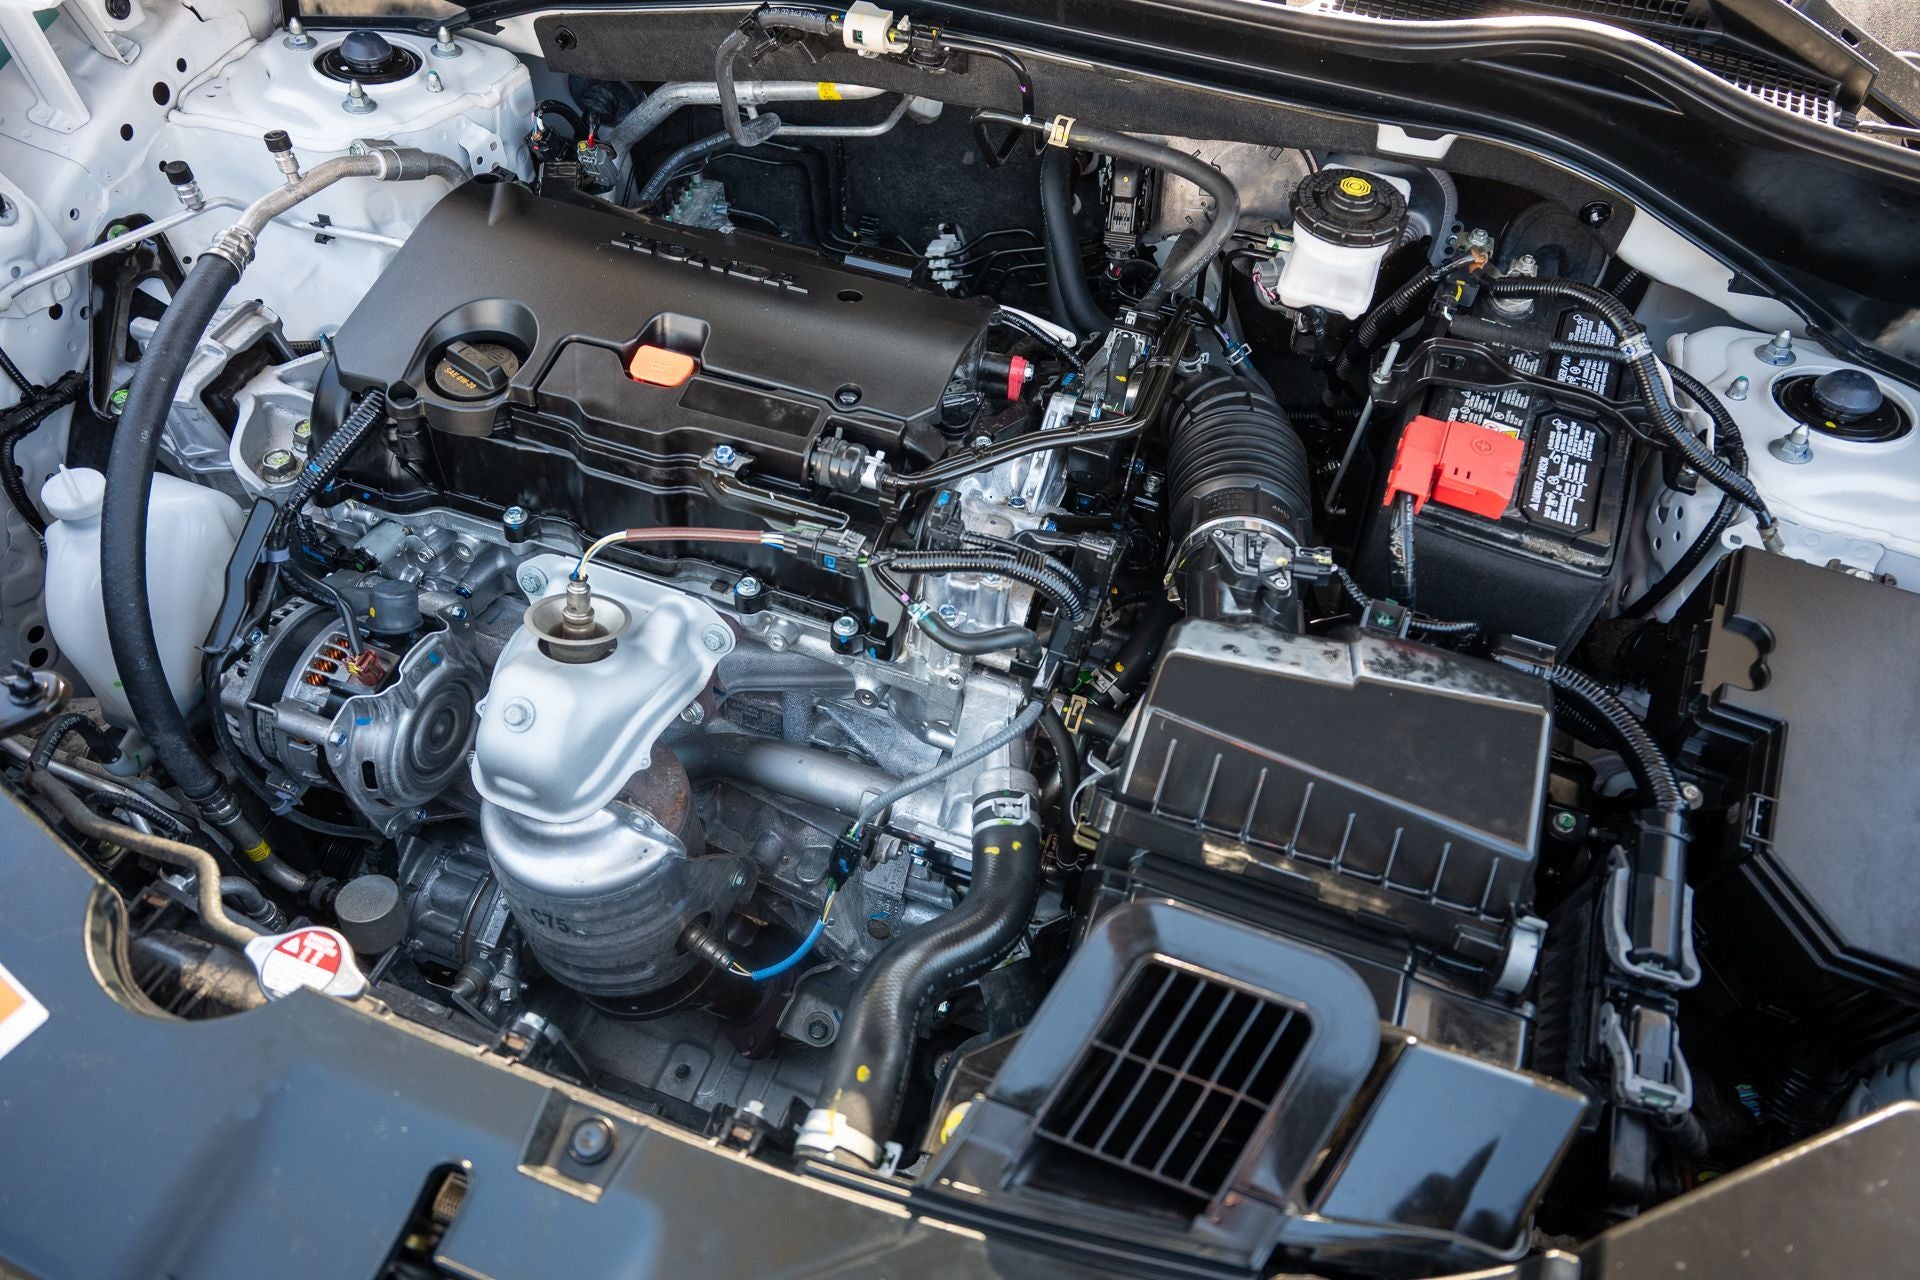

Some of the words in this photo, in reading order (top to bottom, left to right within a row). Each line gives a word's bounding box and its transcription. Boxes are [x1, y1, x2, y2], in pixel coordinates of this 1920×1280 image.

[443, 367, 459, 379] SAE
[456, 375, 478, 390] 0W-20
[530, 908, 570, 933] C75
